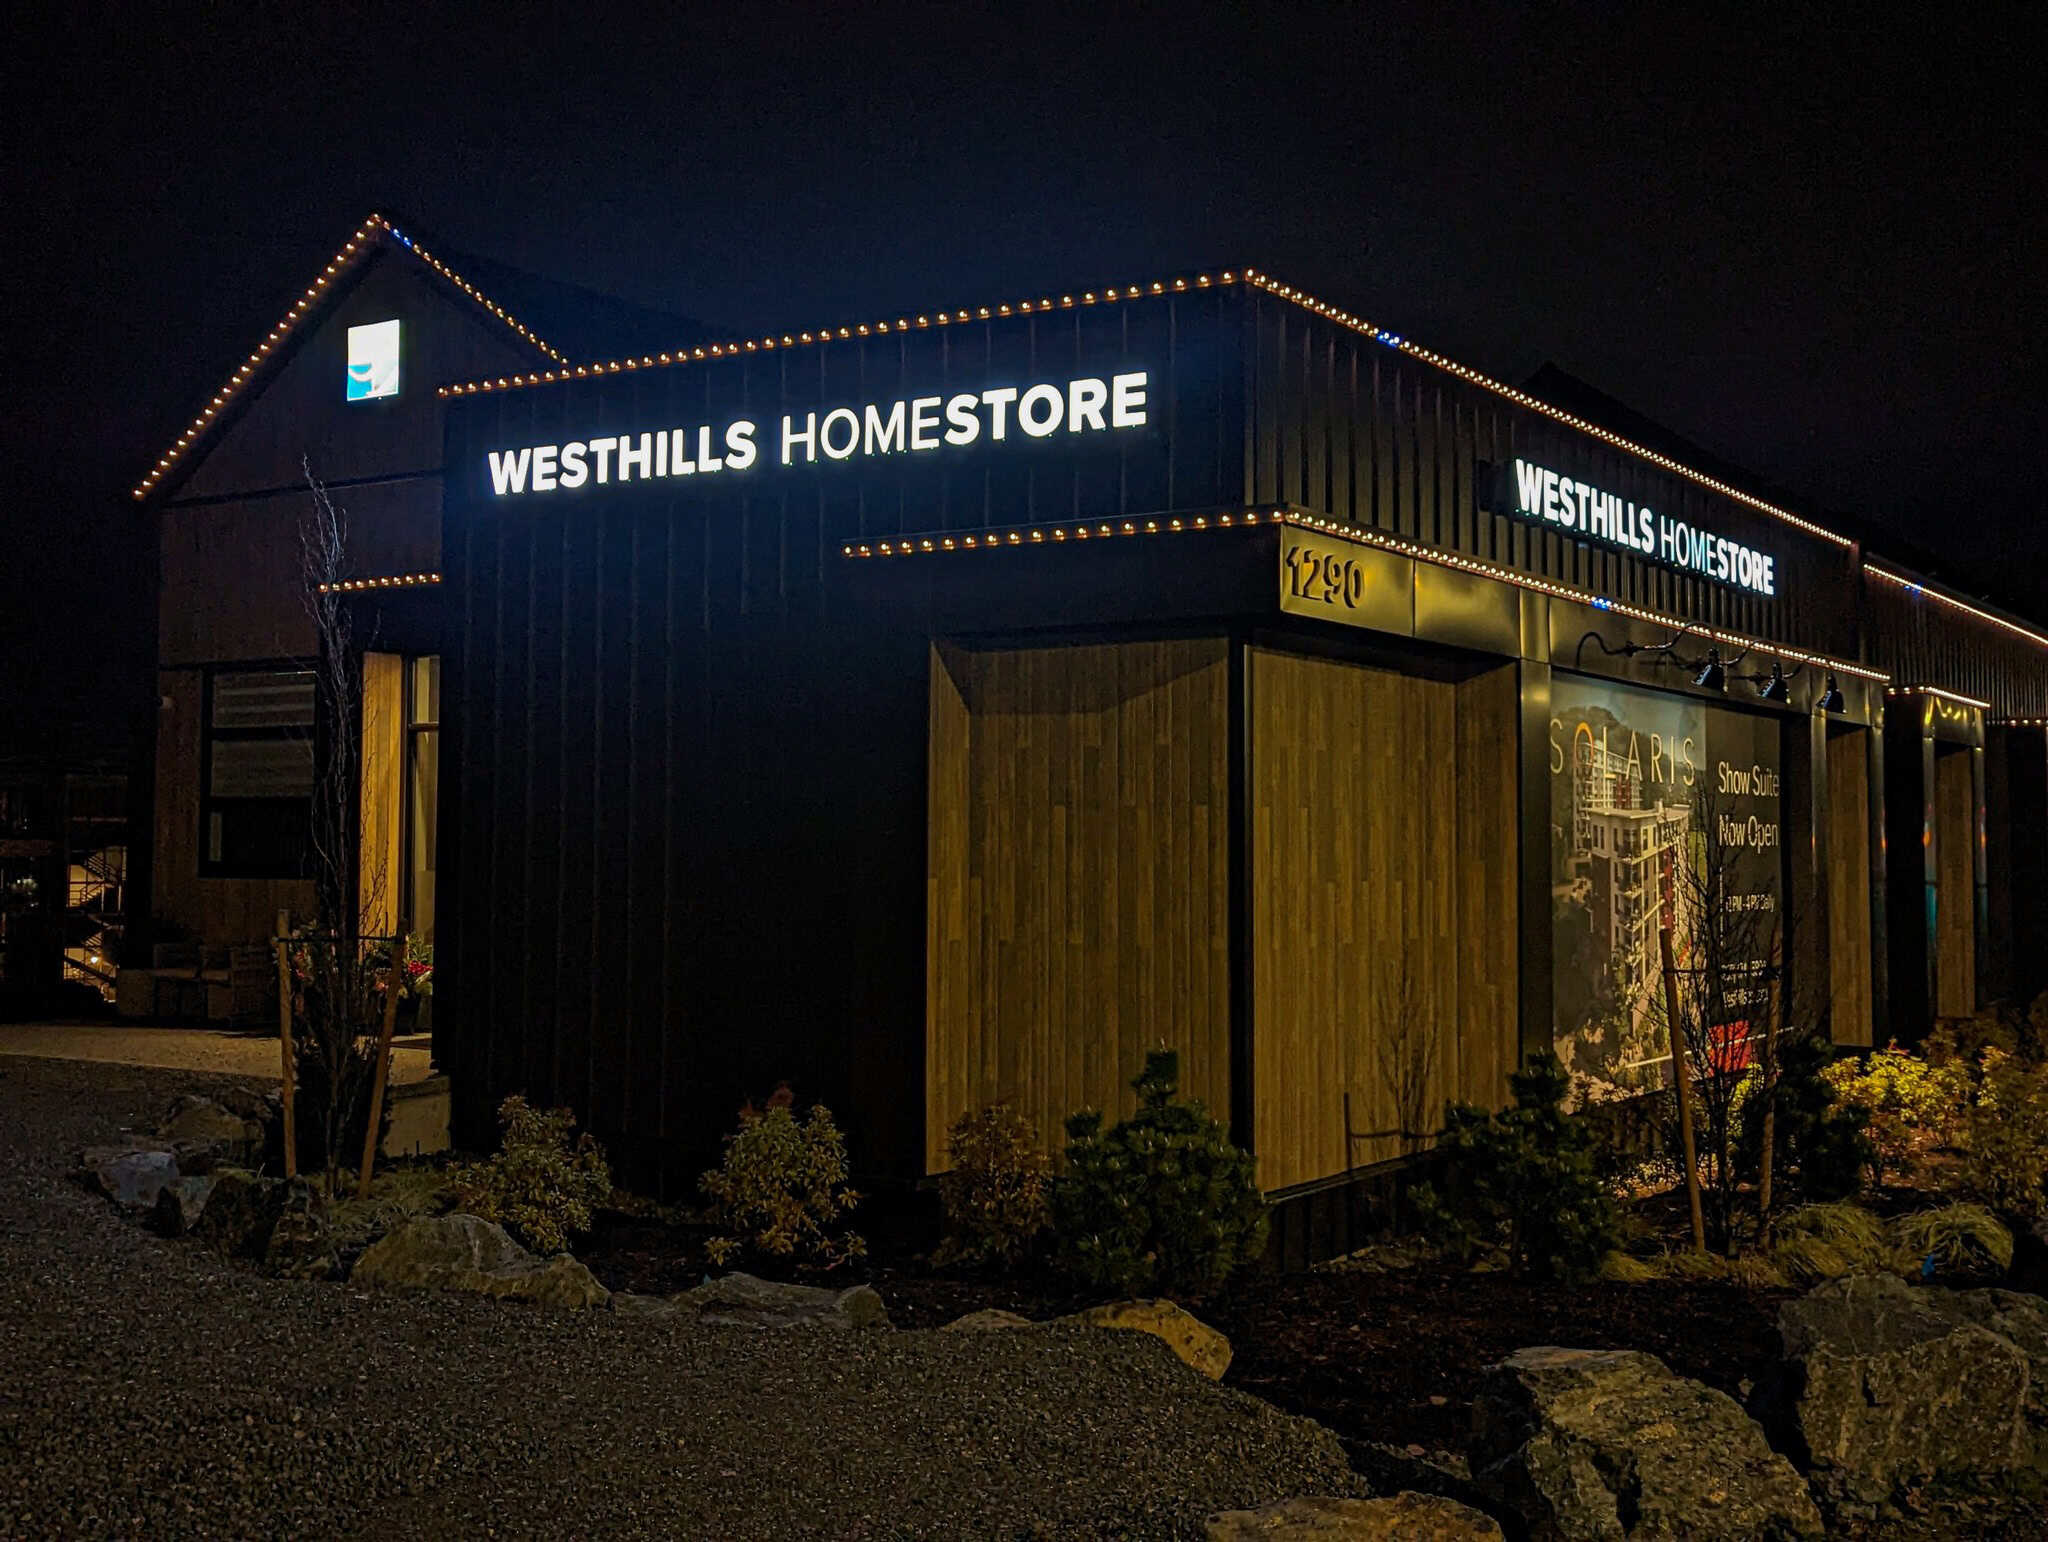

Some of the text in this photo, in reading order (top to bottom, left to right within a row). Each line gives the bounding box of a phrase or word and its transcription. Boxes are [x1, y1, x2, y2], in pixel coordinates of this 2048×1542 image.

[488, 372, 1147, 495] WESTHILLS HOMESTORE
[1515, 458, 1775, 595] WESTHILLS HOMESTORE
[1286, 546, 1363, 609] 1290
[1550, 718, 1695, 786] SOLARIS
[1718, 761, 1780, 797] Show Suite
[1719, 814, 1778, 854] Now Open
